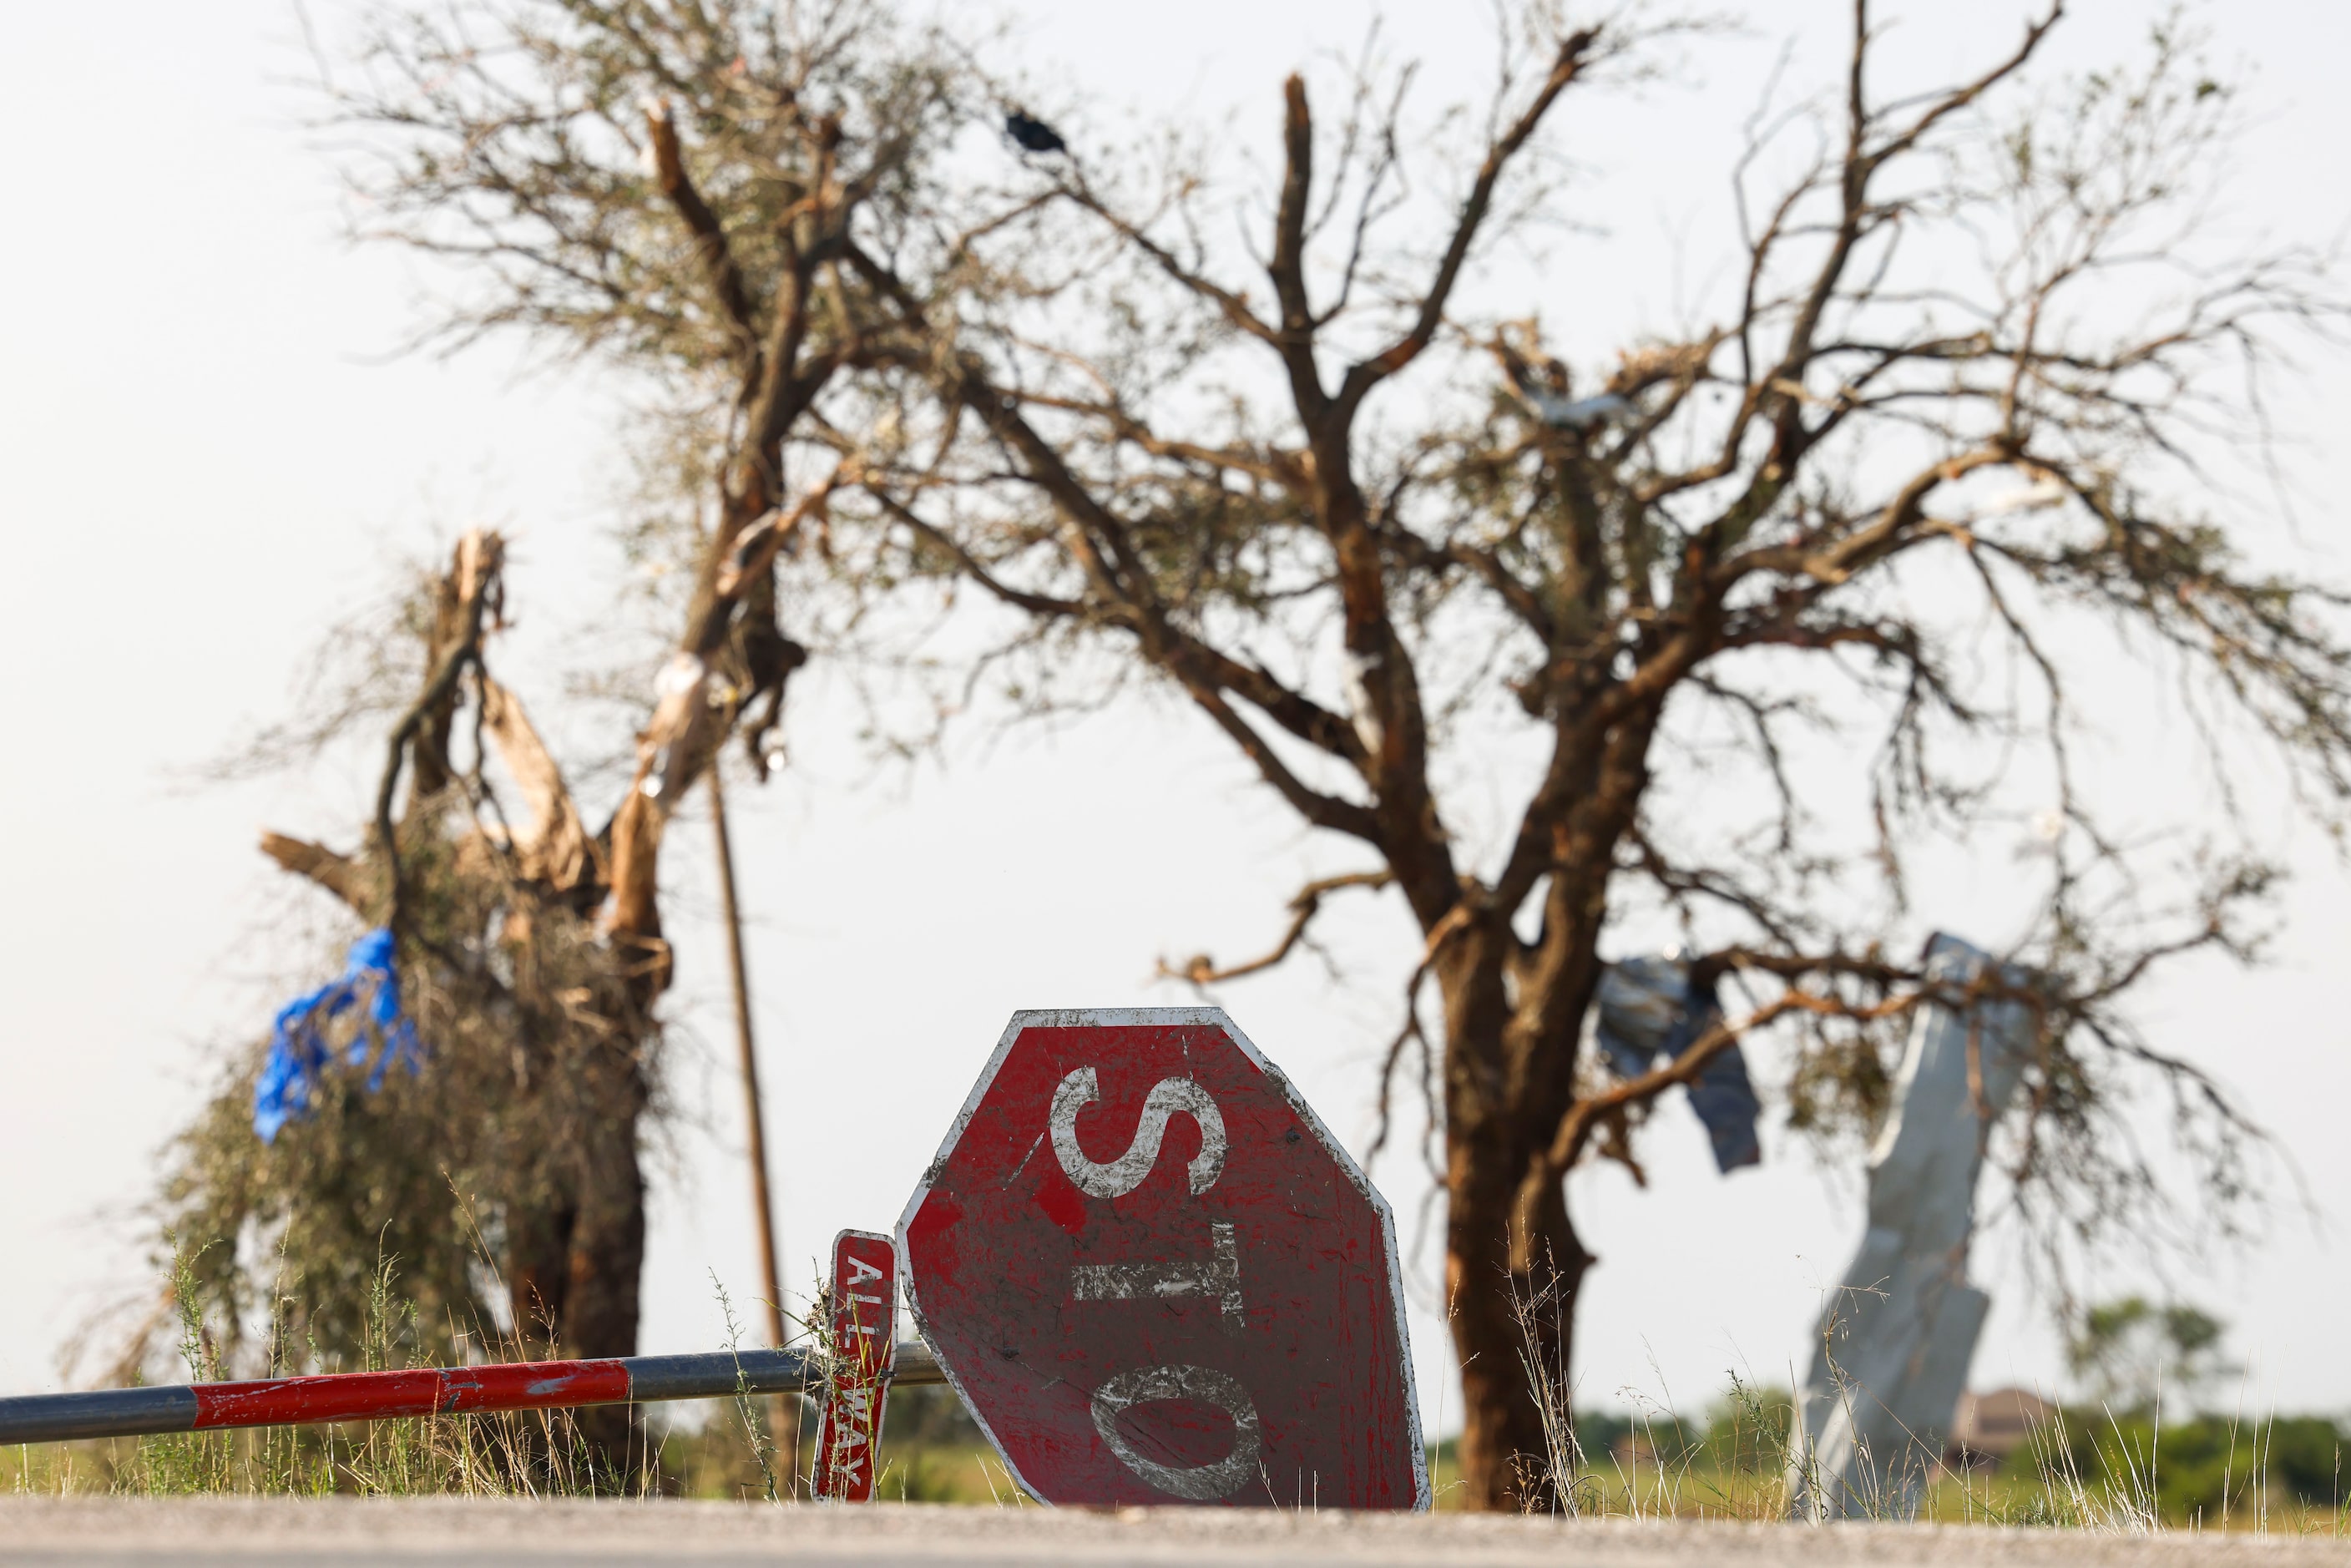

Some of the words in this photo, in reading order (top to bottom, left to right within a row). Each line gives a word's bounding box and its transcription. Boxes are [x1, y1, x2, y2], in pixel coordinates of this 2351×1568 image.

[844, 1255, 882, 1348] ALL
[1049, 1066, 1261, 1500] STO
[834, 1387, 874, 1487] WAY
